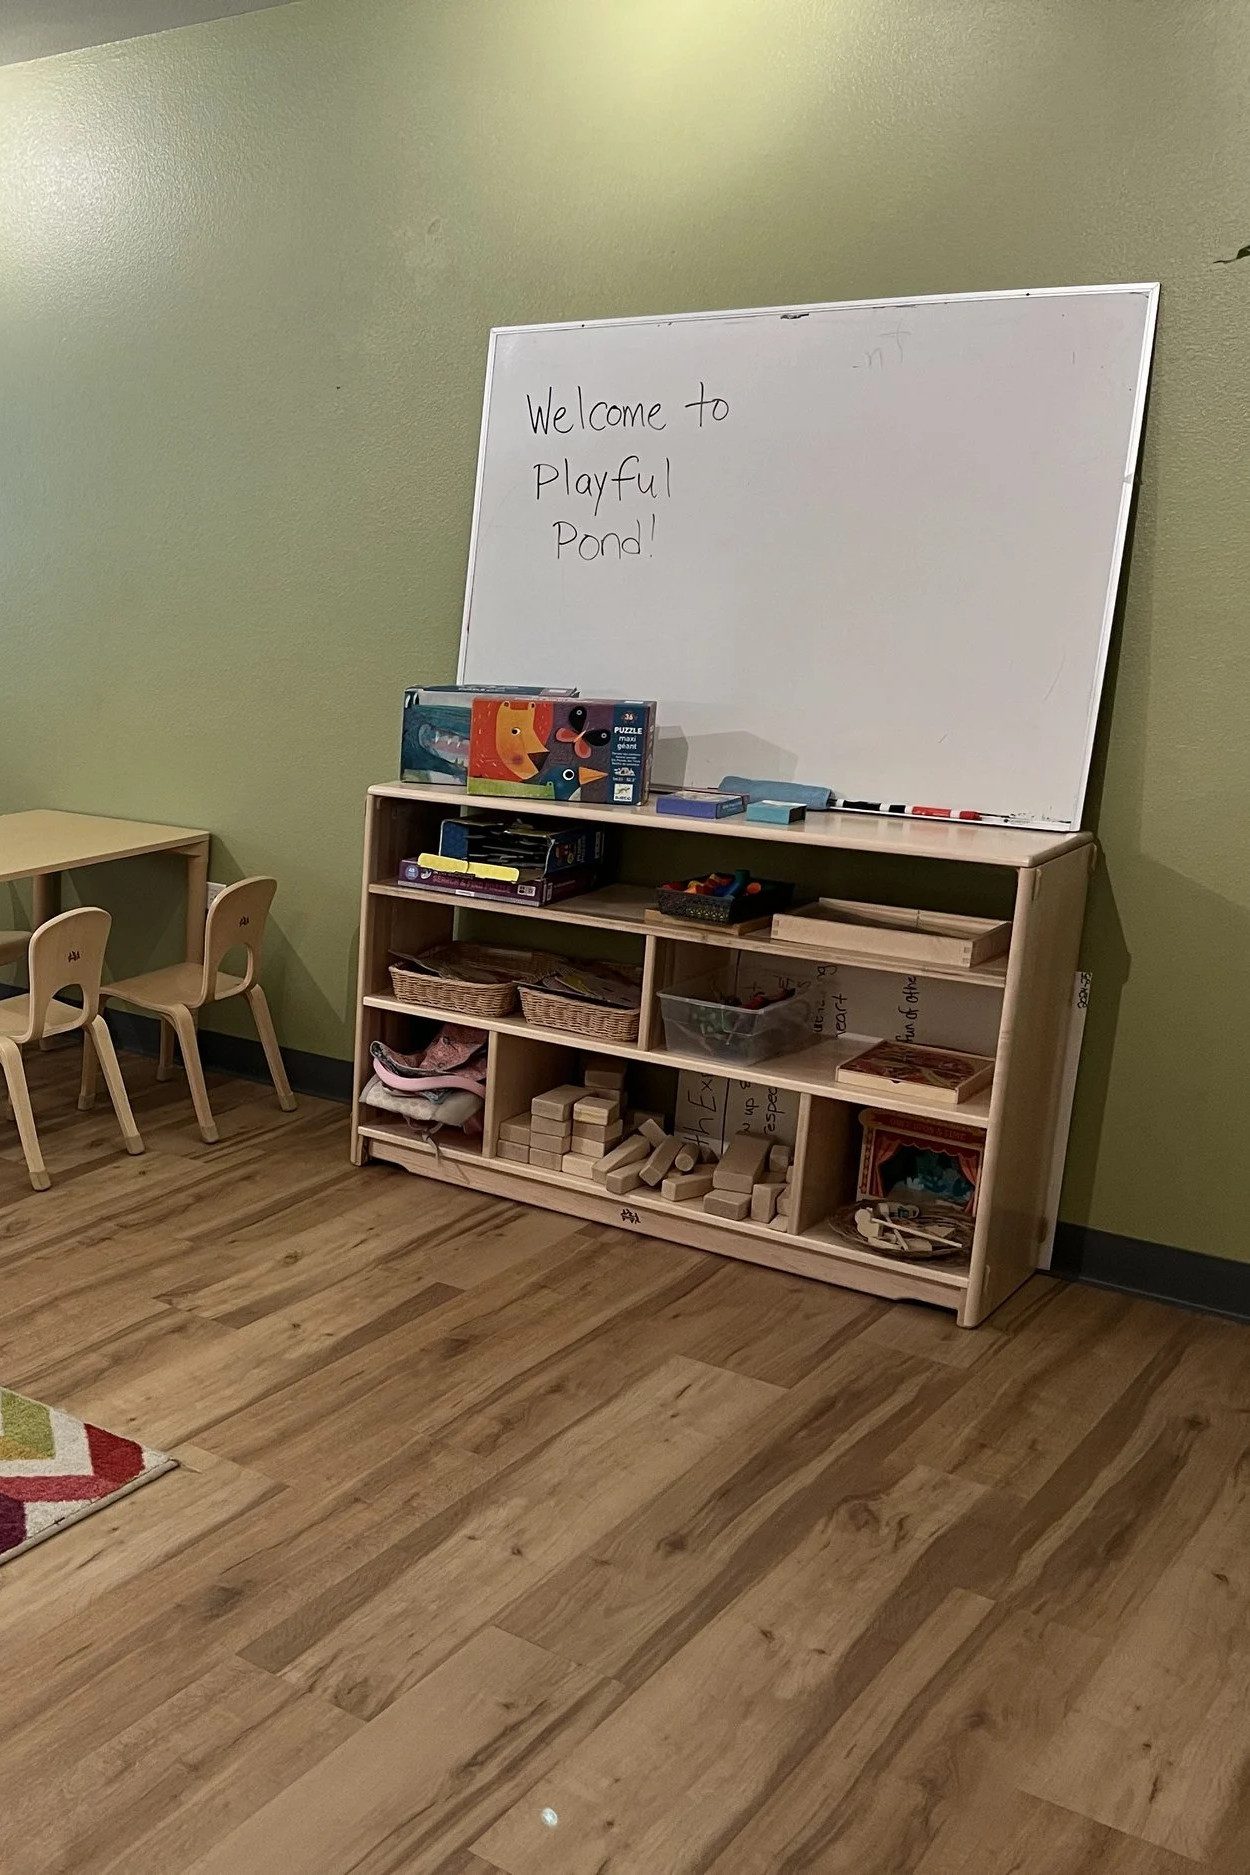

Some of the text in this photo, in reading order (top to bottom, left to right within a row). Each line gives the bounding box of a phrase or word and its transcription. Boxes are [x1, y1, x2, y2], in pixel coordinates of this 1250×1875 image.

[526, 381, 730, 435] Welcome to
[533, 455, 671, 517] Playful
[552, 513, 656, 561] Pond!
[614, 726, 643, 735] PUZZLE
[616, 742, 637, 751] géant
[744, 1097, 760, 1116] up
